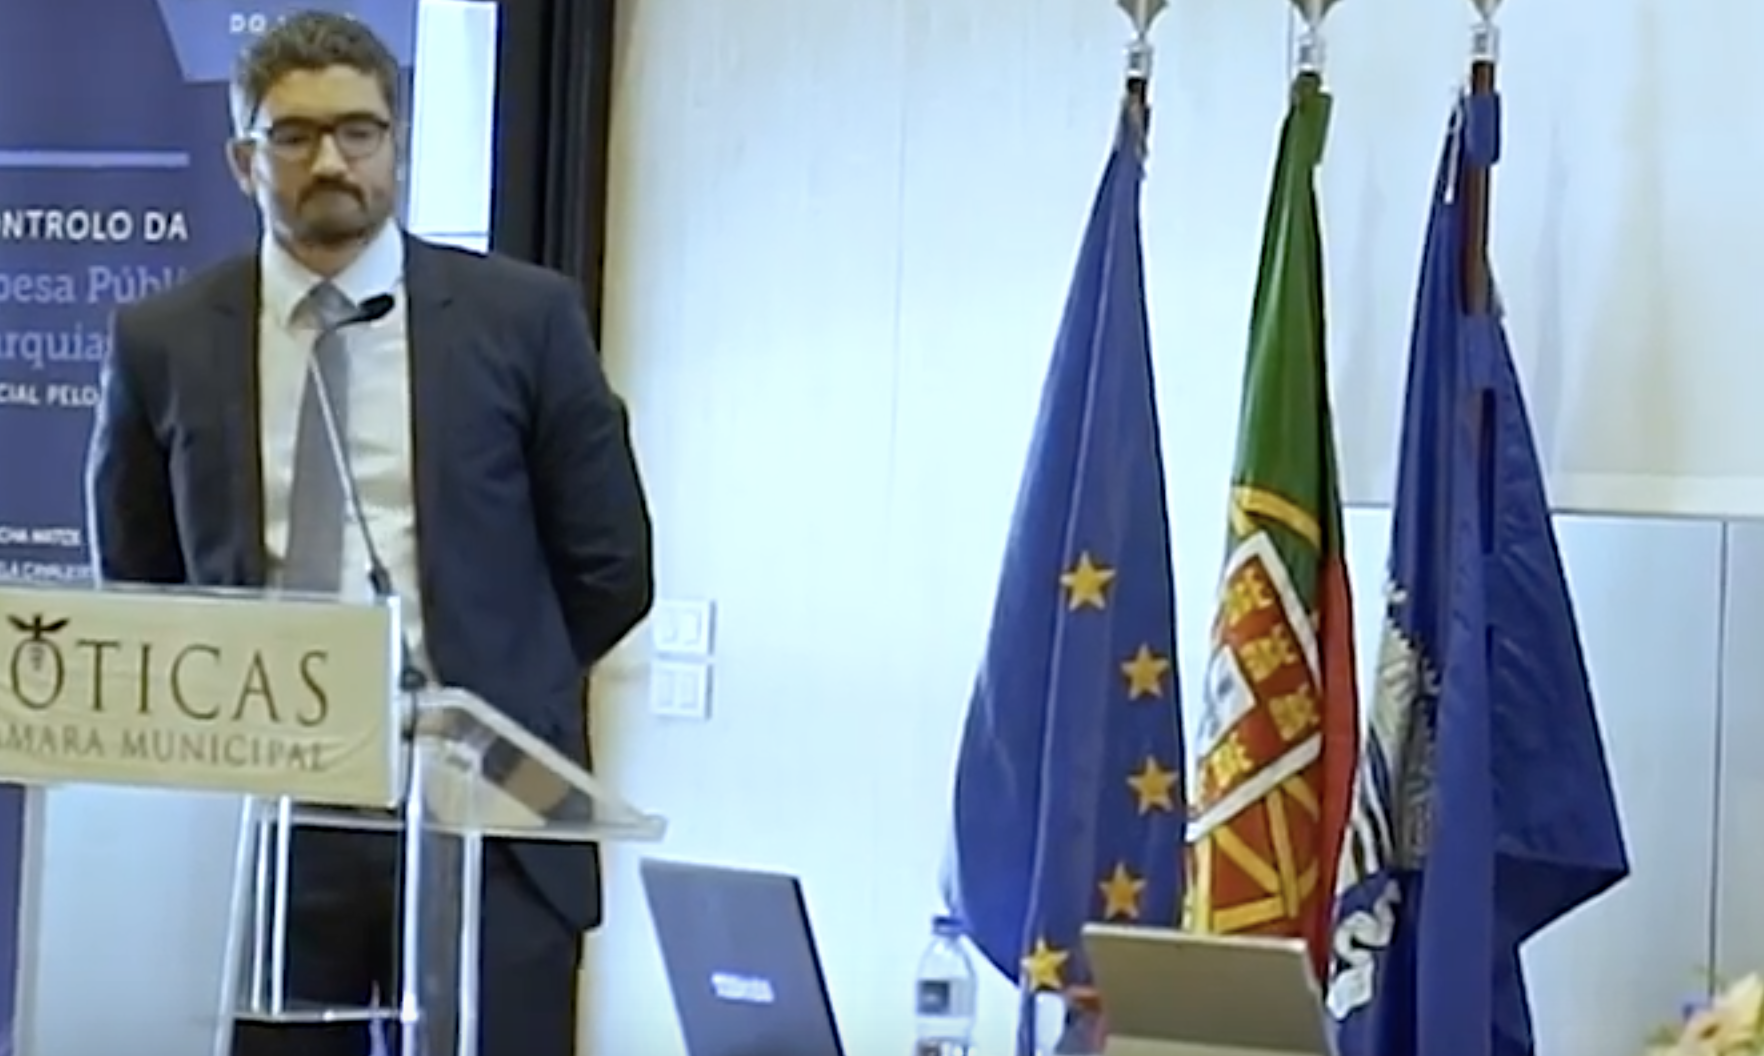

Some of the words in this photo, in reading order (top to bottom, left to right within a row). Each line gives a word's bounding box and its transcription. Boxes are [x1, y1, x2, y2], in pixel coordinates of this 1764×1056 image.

[229, 12, 267, 34] DO
[2, 209, 134, 241] NTROLO
[143, 210, 189, 241] DA
[0, 320, 105, 370] rquia
[120, 728, 331, 773] MUNICIPAL
